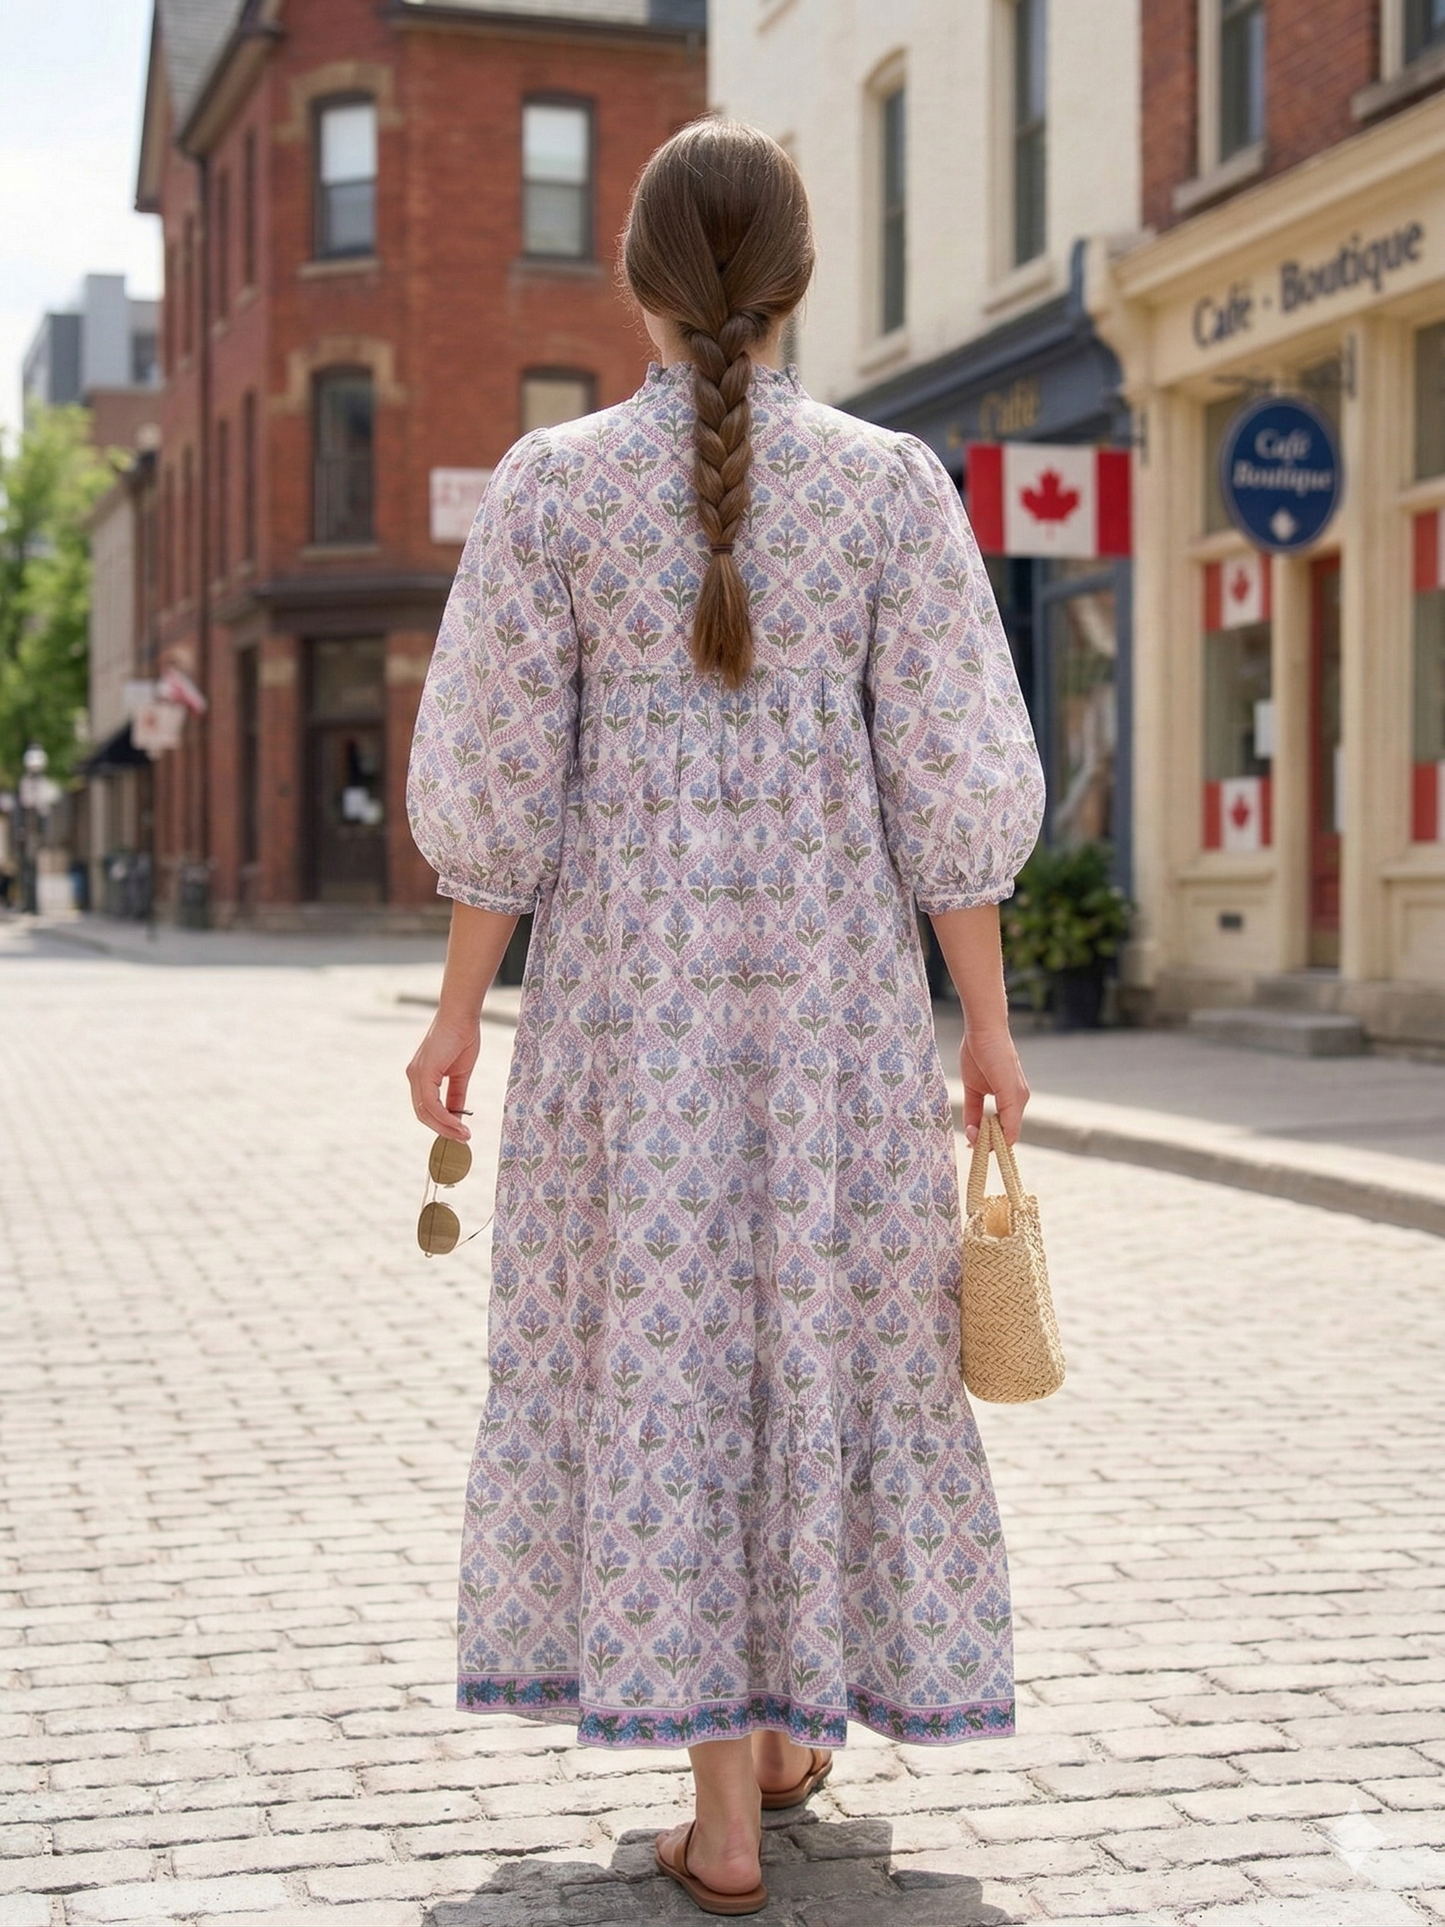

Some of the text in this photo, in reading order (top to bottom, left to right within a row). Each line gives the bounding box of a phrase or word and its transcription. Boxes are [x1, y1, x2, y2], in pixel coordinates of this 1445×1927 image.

[1193, 278, 1253, 347] Café
[1280, 221, 1424, 316] Boutique
[1254, 427, 1312, 467] Café
[1233, 459, 1334, 498] Boutique
